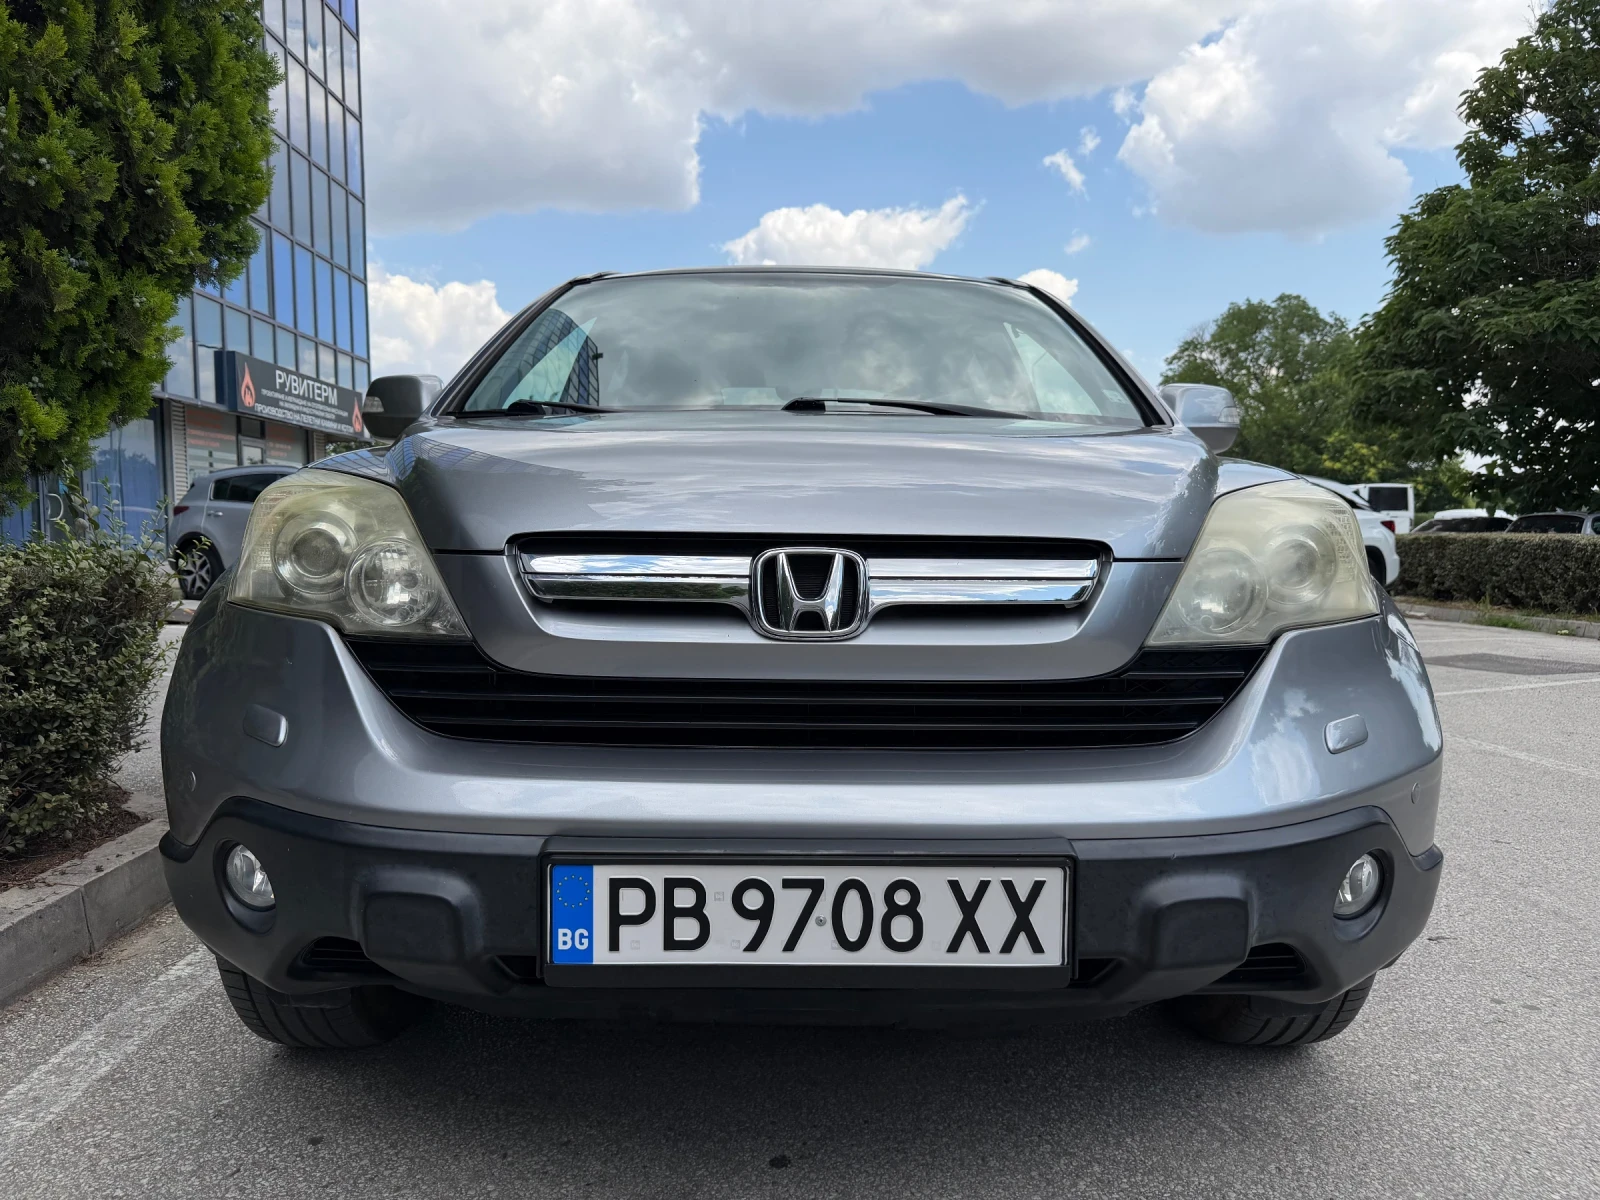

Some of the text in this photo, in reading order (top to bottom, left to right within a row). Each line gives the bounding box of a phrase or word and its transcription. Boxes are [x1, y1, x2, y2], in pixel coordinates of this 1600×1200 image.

[275, 369, 338, 407] РУВИТЕРМ
[608, 877, 1046, 954] PB 9708 XX
[557, 928, 589, 950] BG
